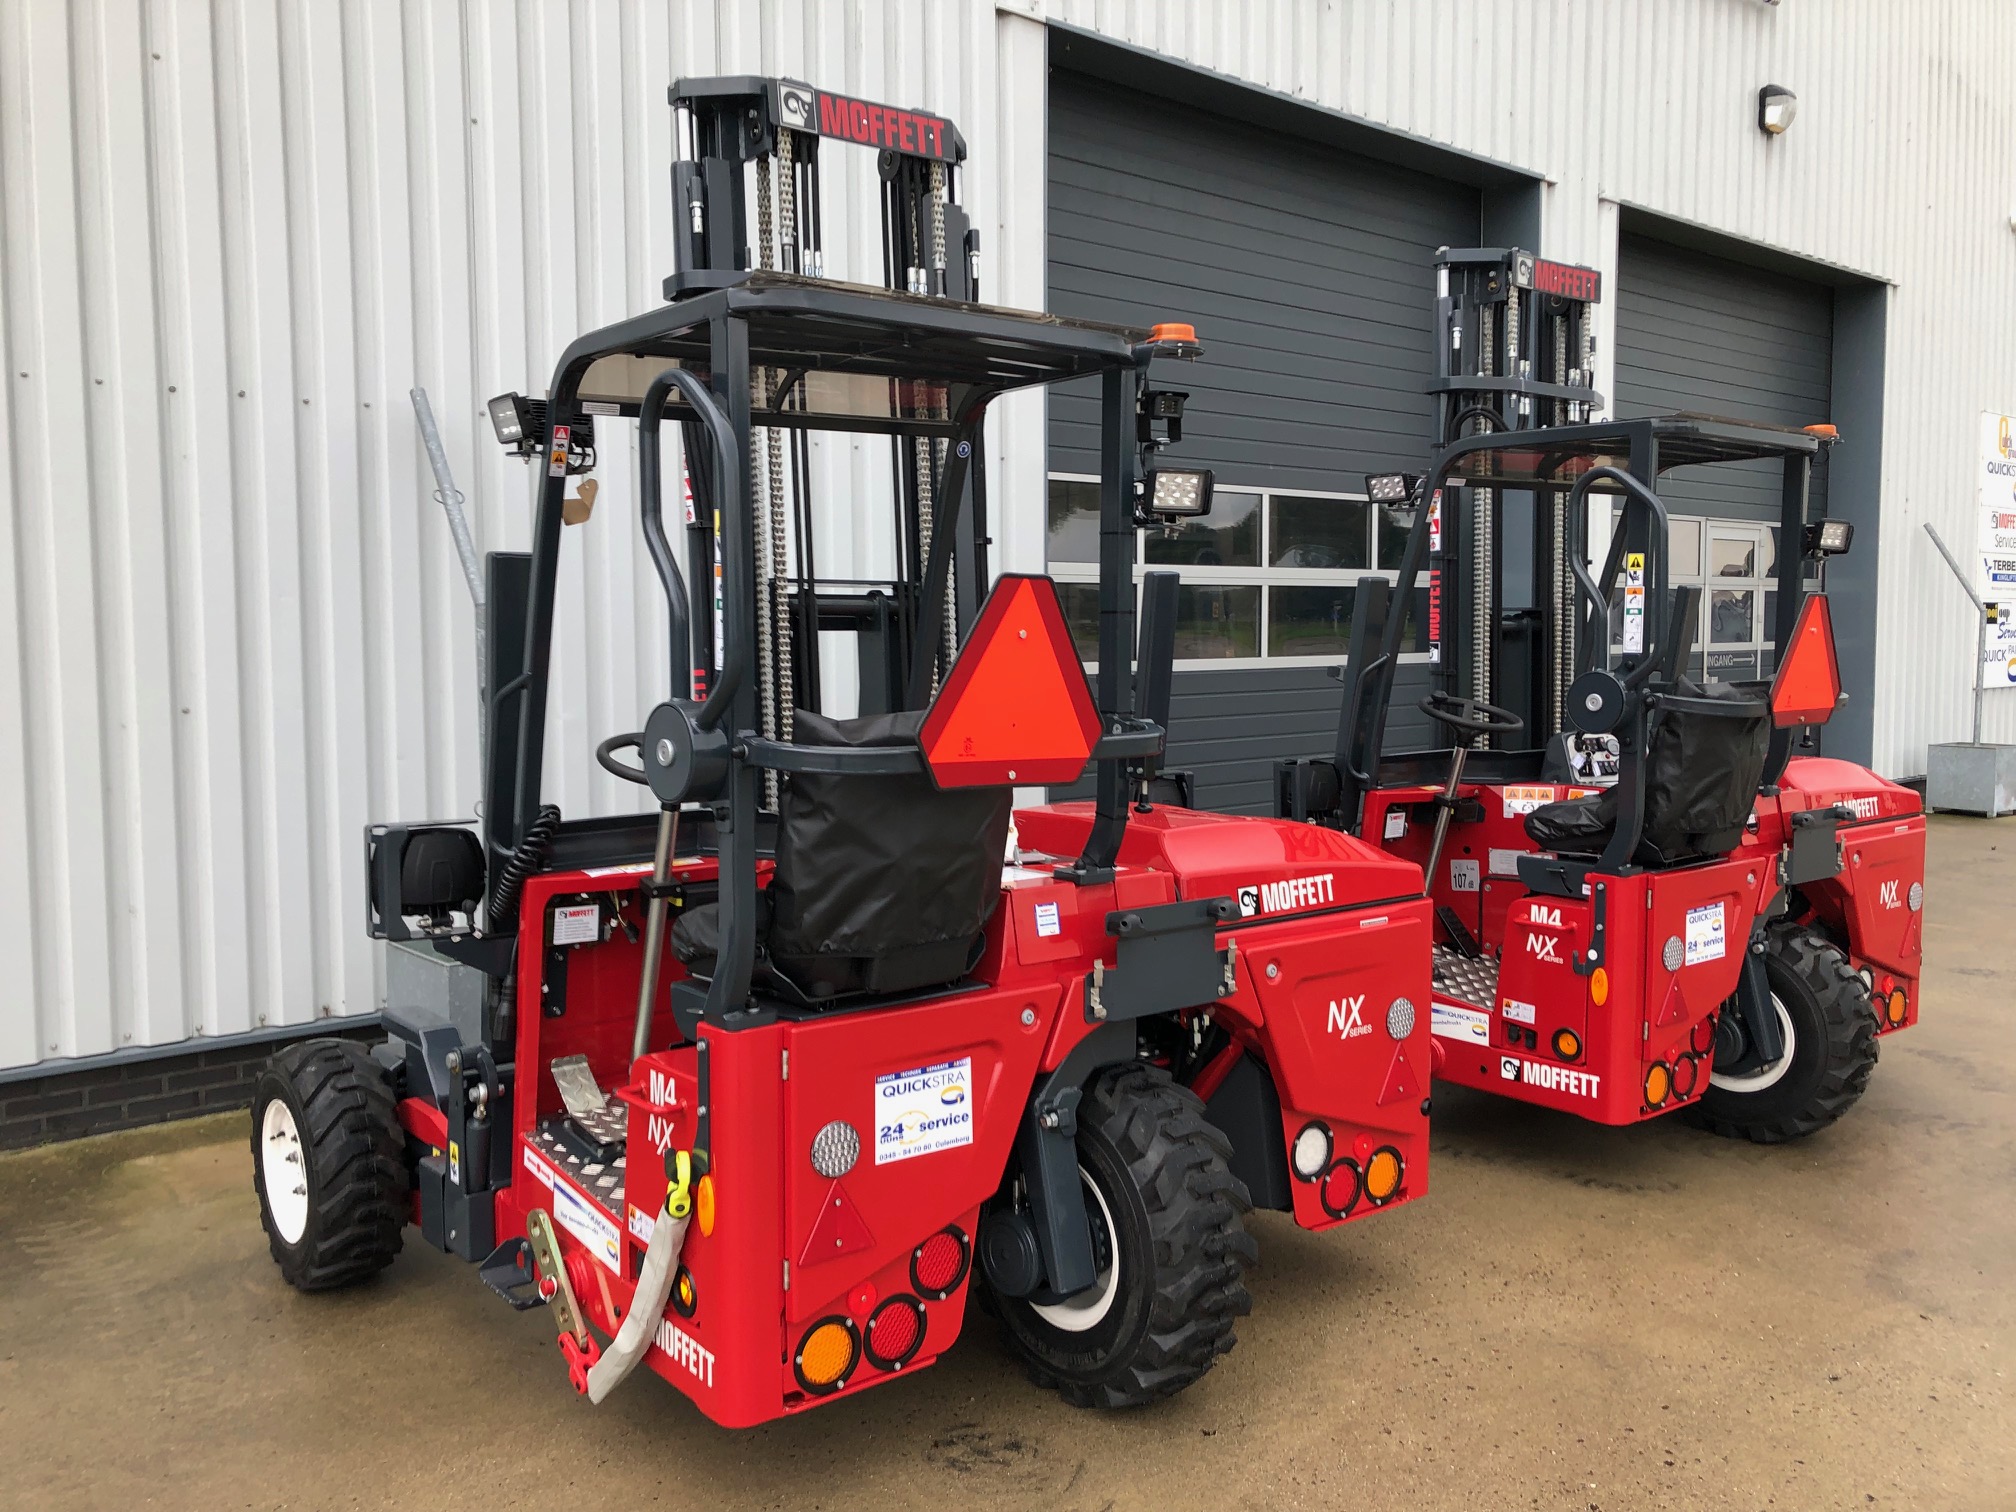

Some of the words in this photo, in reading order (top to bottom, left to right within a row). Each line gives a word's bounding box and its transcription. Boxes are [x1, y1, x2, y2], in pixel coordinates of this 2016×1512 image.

[819, 93, 945, 157] MOFFETT
[1535, 260, 1598, 300] MOFFETT
[1261, 873, 1334, 913] MOFFETT
[1453, 873, 1467, 889] 107
[1880, 879, 1899, 910] NX
[1530, 904, 1562, 927] M4
[1688, 910, 1722, 925] QUICKSTRA
[1526, 932, 1559, 960] NX
[1703, 936, 1724, 948] service
[1543, 954, 1564, 964] SERIES
[1327, 994, 1365, 1040] NX
[1448, 1012, 1488, 1025] QUICKSTRA
[1349, 1024, 1373, 1038] SERIES
[650, 1068, 677, 1108] M4
[883, 1071, 965, 1098] QUICKSTRA
[1523, 1060, 1600, 1099] MOFFETT
[648, 1113, 675, 1156] NX
[880, 1123, 904, 1139] 24
[919, 1112, 970, 1132] service
